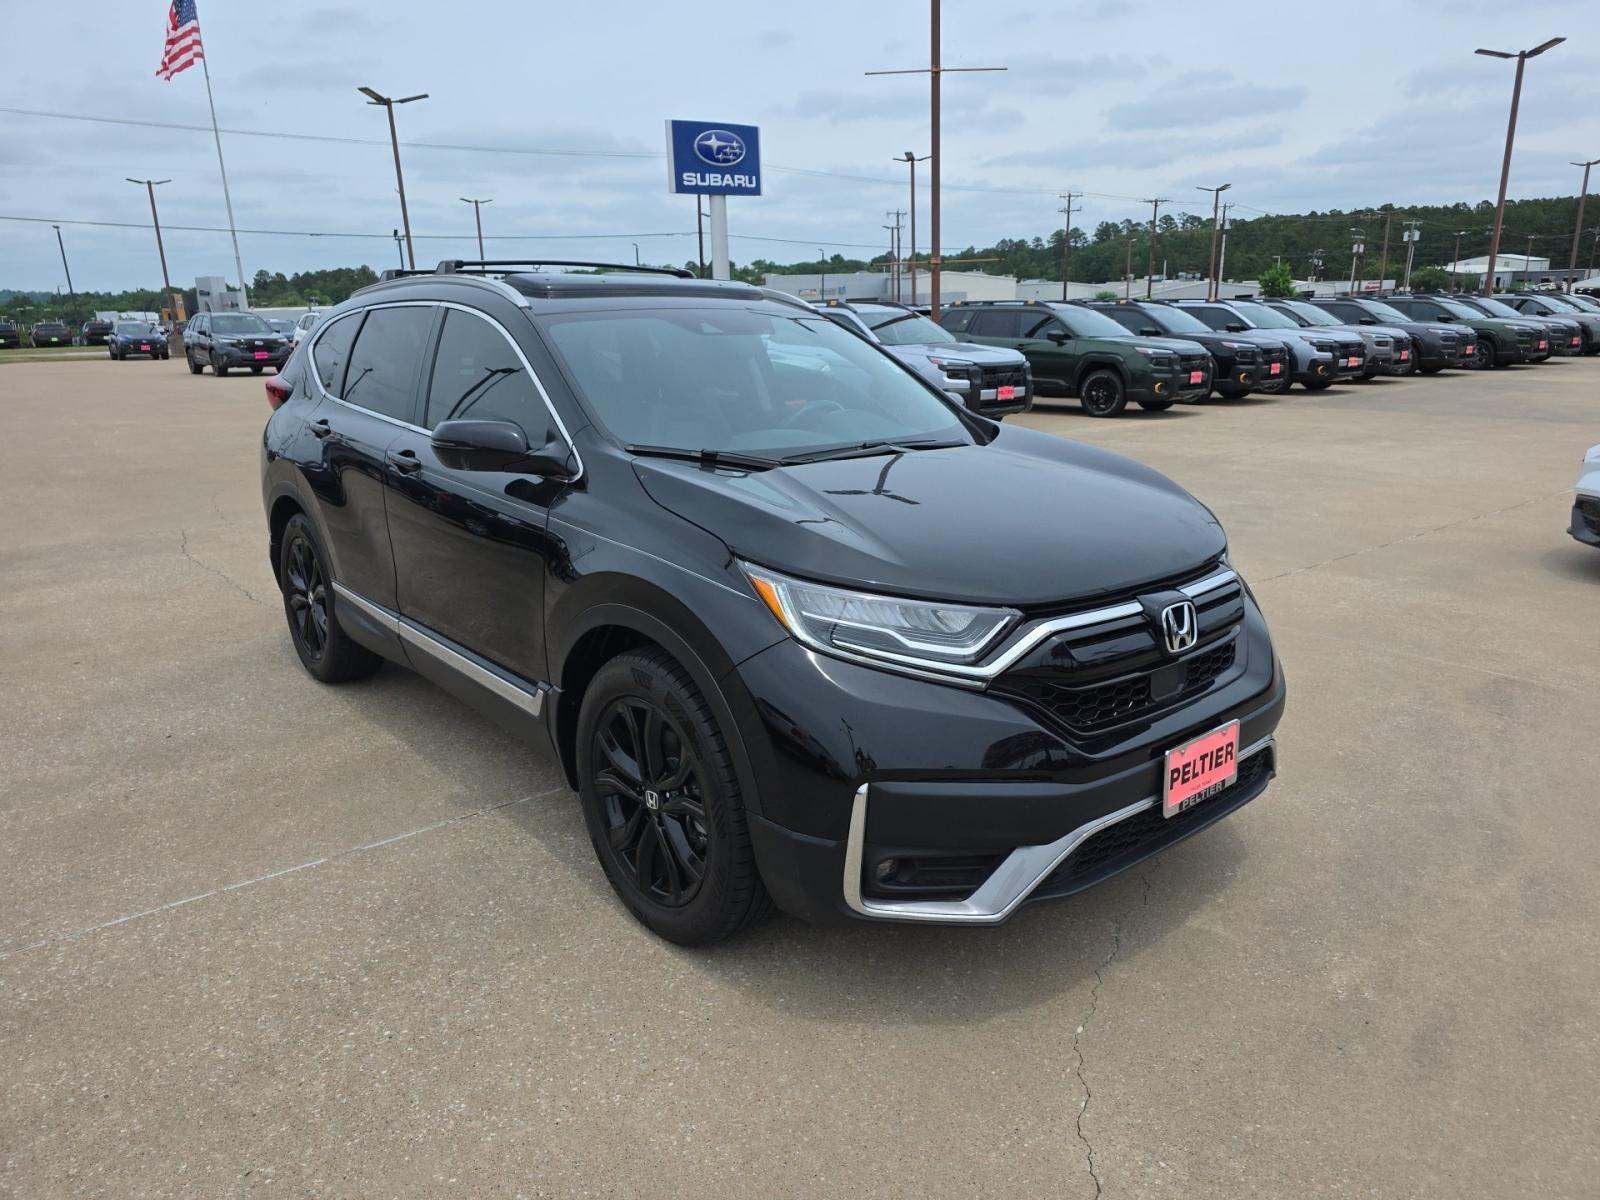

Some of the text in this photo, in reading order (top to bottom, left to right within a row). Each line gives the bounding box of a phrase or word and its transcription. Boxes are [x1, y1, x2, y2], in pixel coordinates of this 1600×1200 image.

[682, 172, 756, 188] SUBARU
[1169, 741, 1234, 790] PELTIER
[1182, 780, 1222, 808] PELTIER
